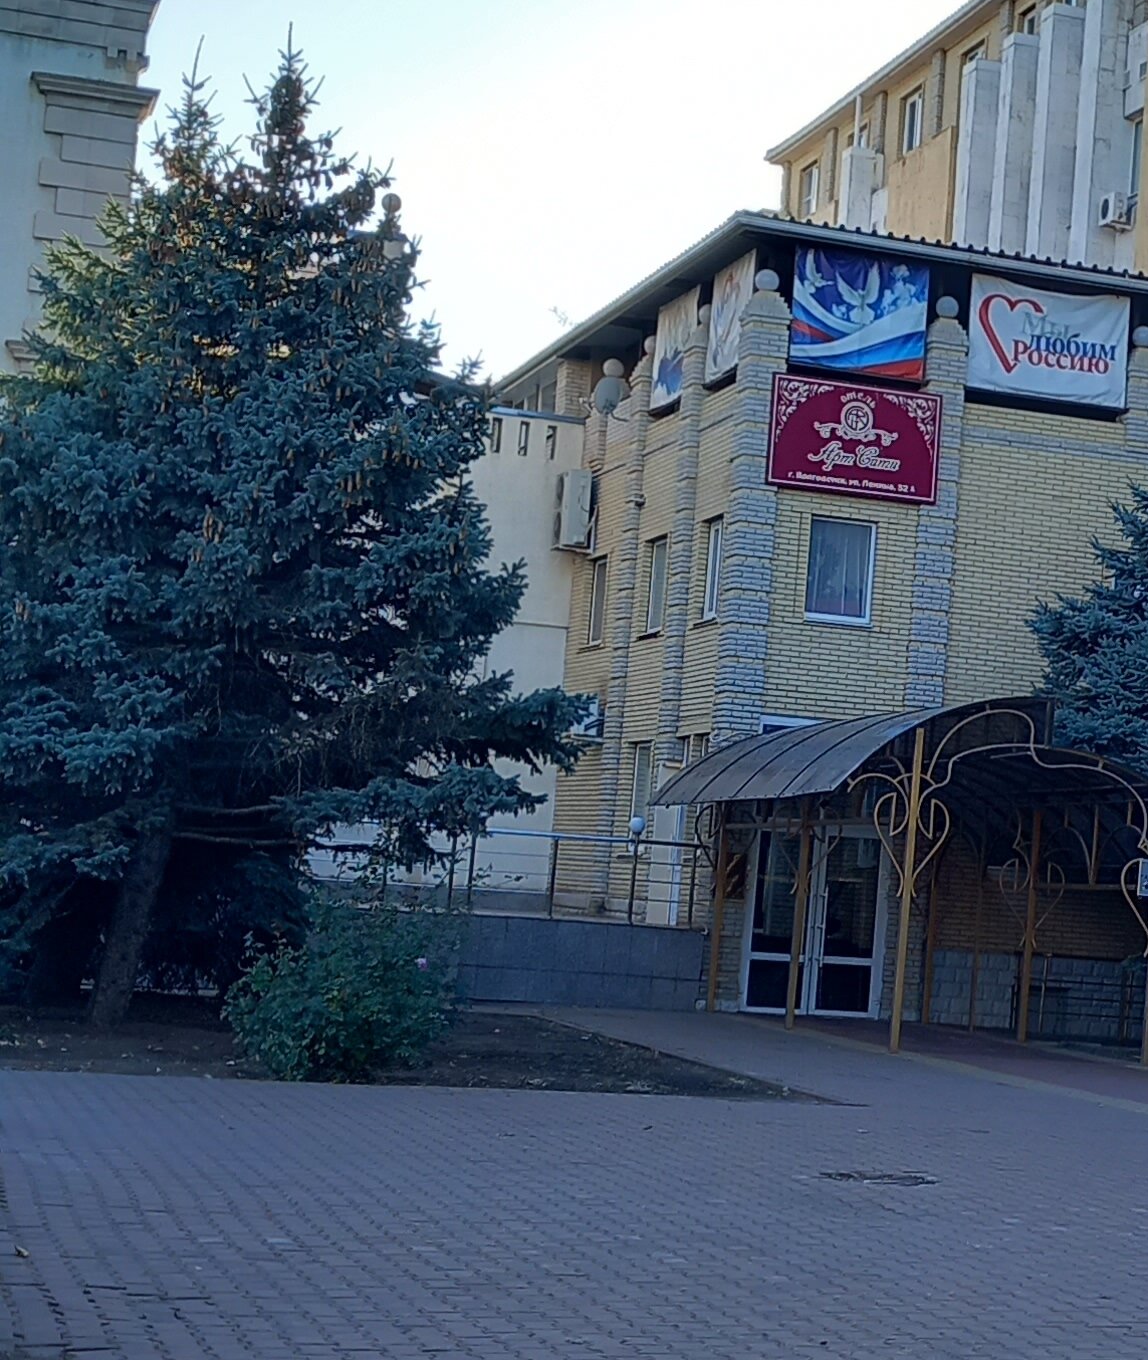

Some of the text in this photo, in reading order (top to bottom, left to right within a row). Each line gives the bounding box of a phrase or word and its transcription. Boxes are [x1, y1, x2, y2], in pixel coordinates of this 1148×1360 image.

[1022, 311, 1070, 338] Мы
[1011, 339, 1110, 375] Россию
[1029, 333, 1117, 361] любим
[807, 440, 855, 471] Арт
